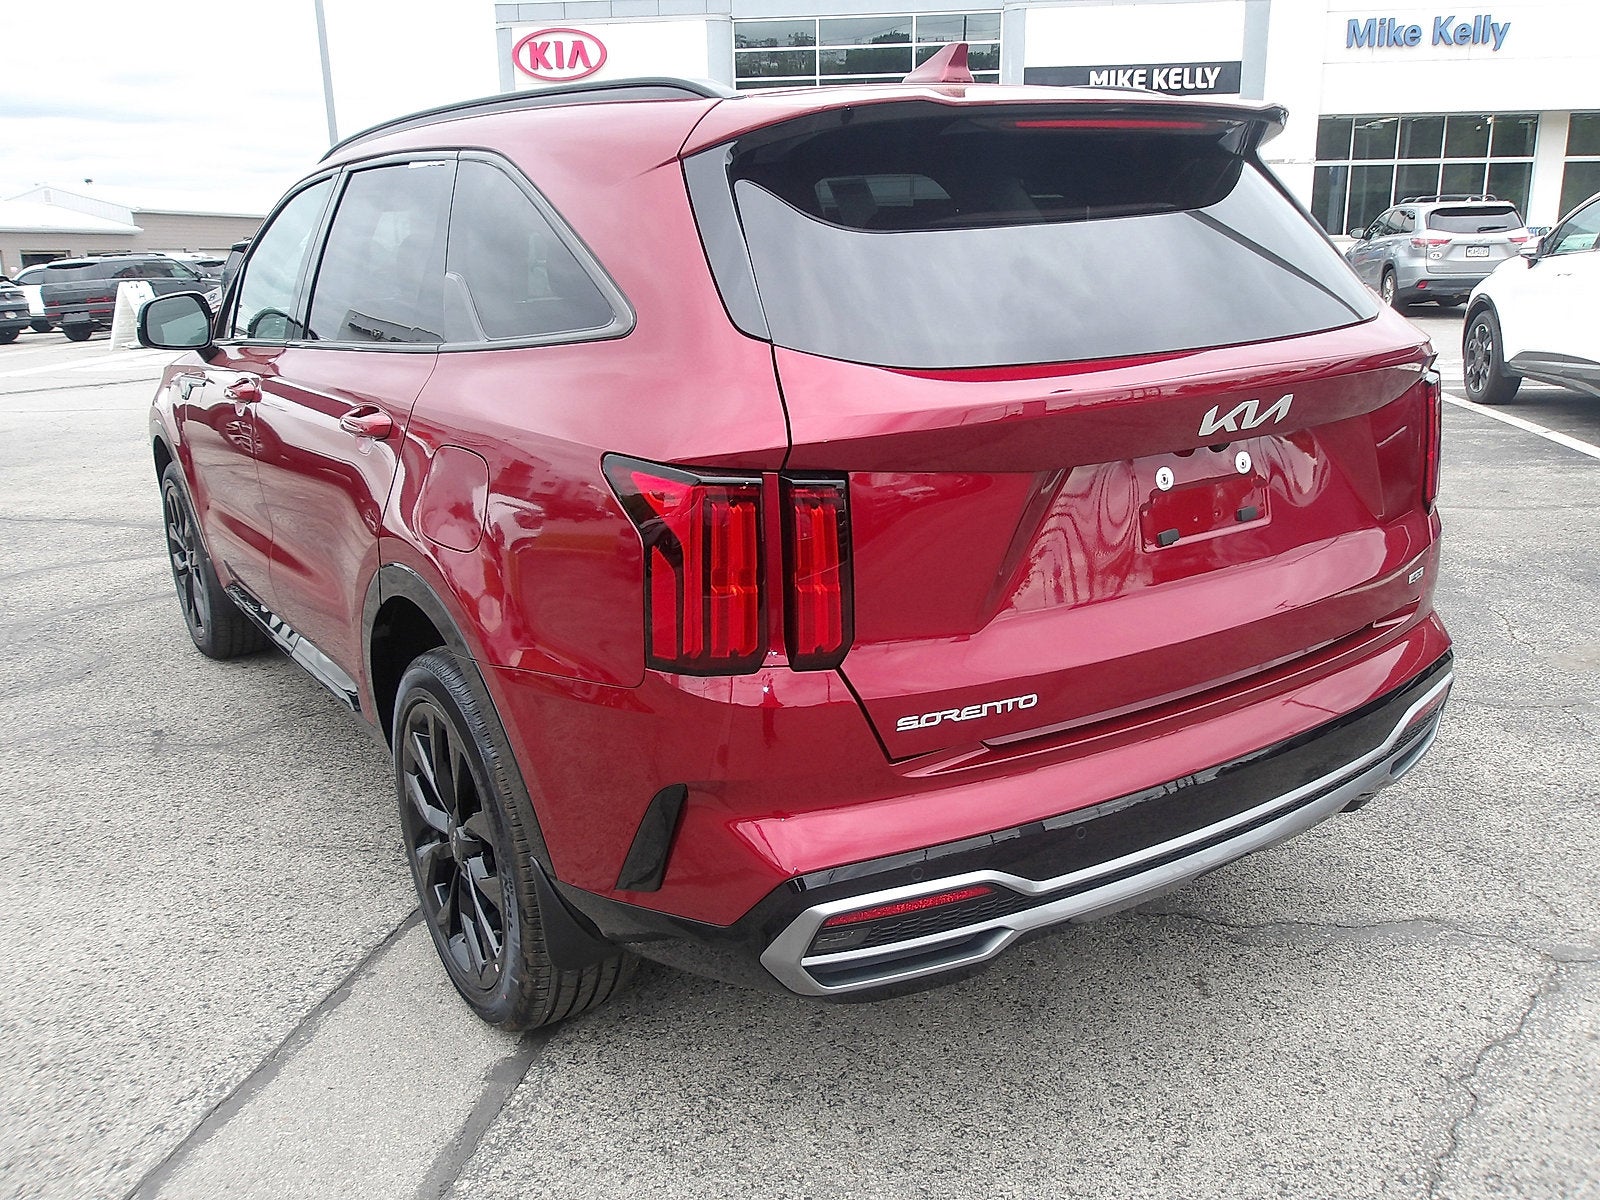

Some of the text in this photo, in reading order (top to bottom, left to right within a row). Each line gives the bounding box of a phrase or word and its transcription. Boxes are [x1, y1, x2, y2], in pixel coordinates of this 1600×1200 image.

[1346, 15, 1511, 51] Mike Kelly
[527, 40, 592, 69] KIA
[1089, 66, 1222, 91] MIKE KELLY
[1198, 393, 1294, 436] KIA
[896, 693, 1038, 732] SORENTO
